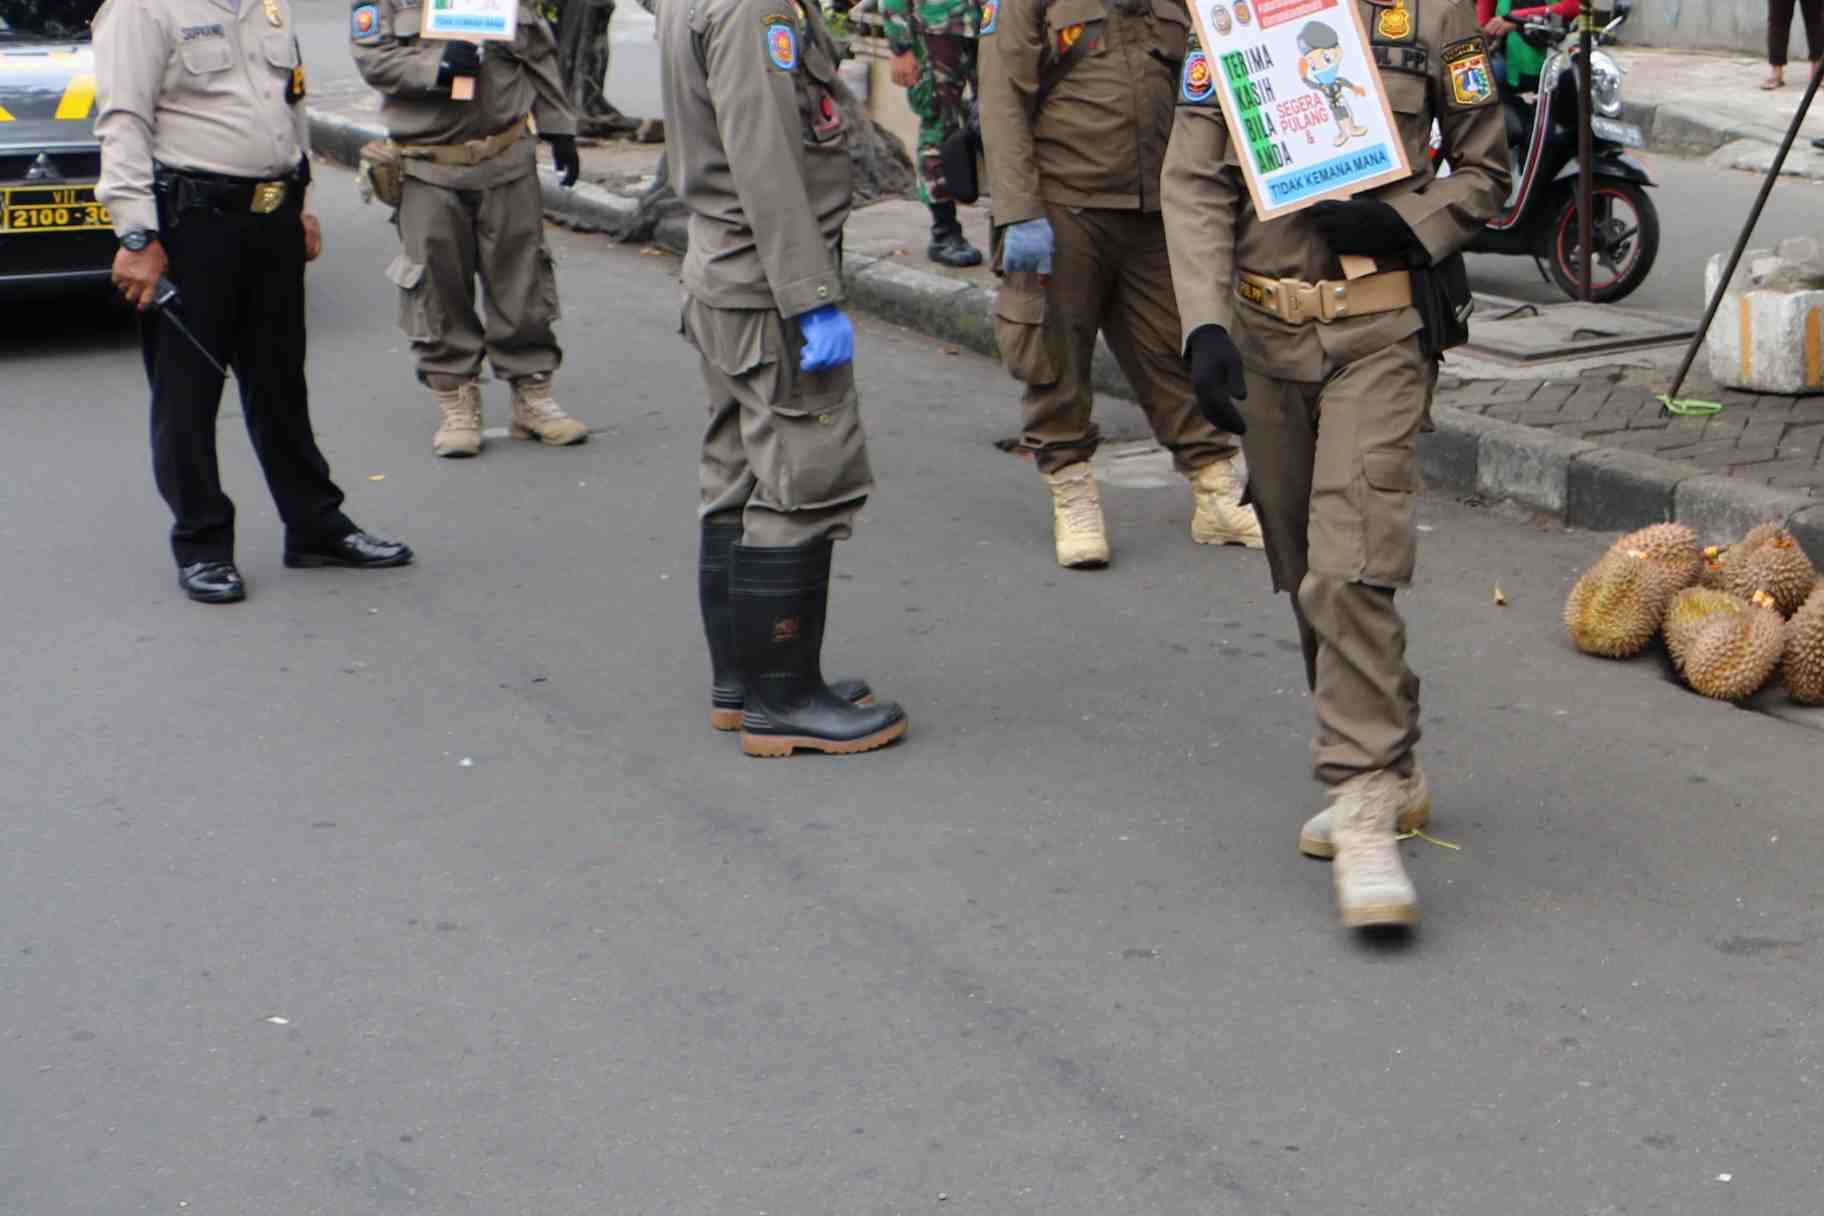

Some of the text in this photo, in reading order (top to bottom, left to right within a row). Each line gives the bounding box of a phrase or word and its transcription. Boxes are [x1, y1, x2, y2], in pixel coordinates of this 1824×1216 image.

[1221, 43, 1274, 81] TERIMA
[1236, 78, 1277, 112] KASIH
[1276, 92, 1325, 119] SEGERA
[1244, 112, 1277, 143] BILA
[1279, 106, 1329, 133] PULANG
[1256, 141, 1293, 175] ANDA
[1270, 149, 1387, 199] TIDAK KEMANA MANA
